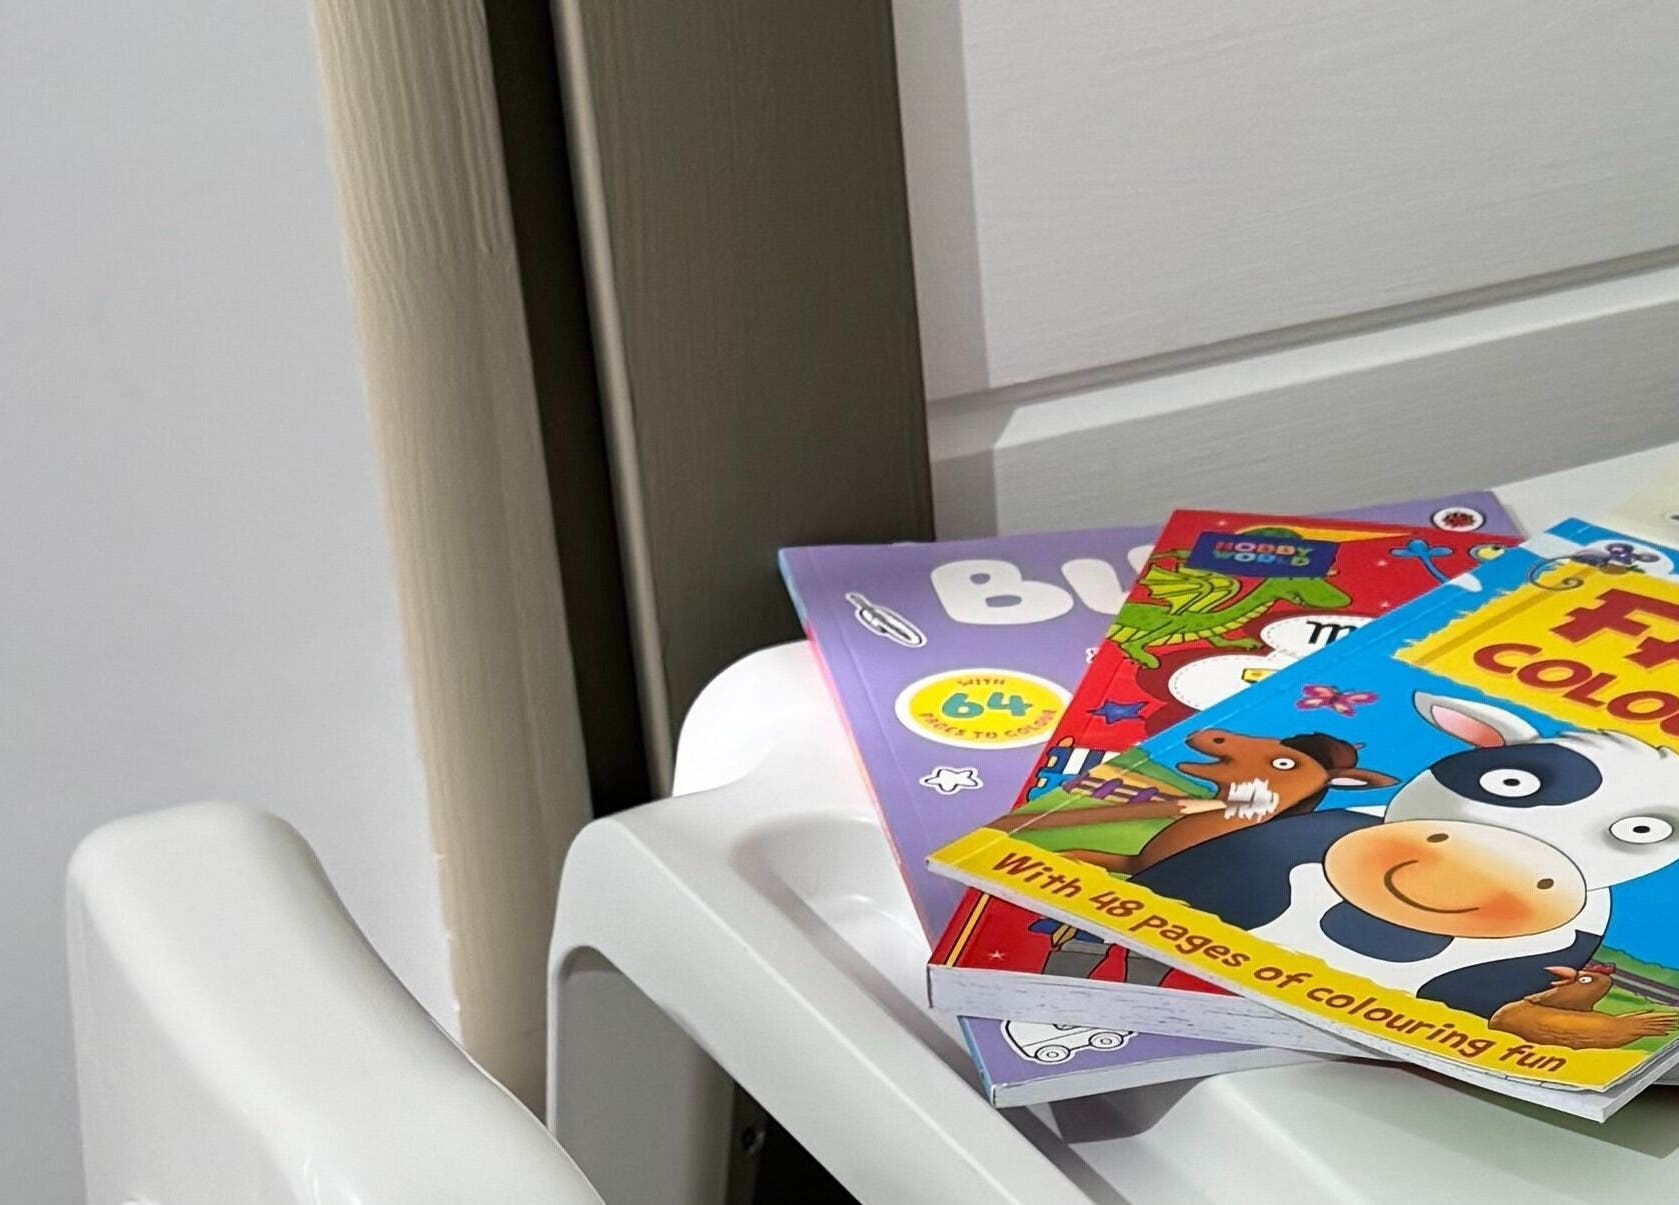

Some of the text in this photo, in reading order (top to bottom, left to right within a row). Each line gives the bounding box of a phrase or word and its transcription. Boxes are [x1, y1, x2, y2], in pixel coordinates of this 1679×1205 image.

[930, 544, 1155, 625] BU
[942, 692, 1033, 718] 64
[973, 731, 998, 739] TO
[992, 852, 1567, 1073] With 48 pages of colouring fun
